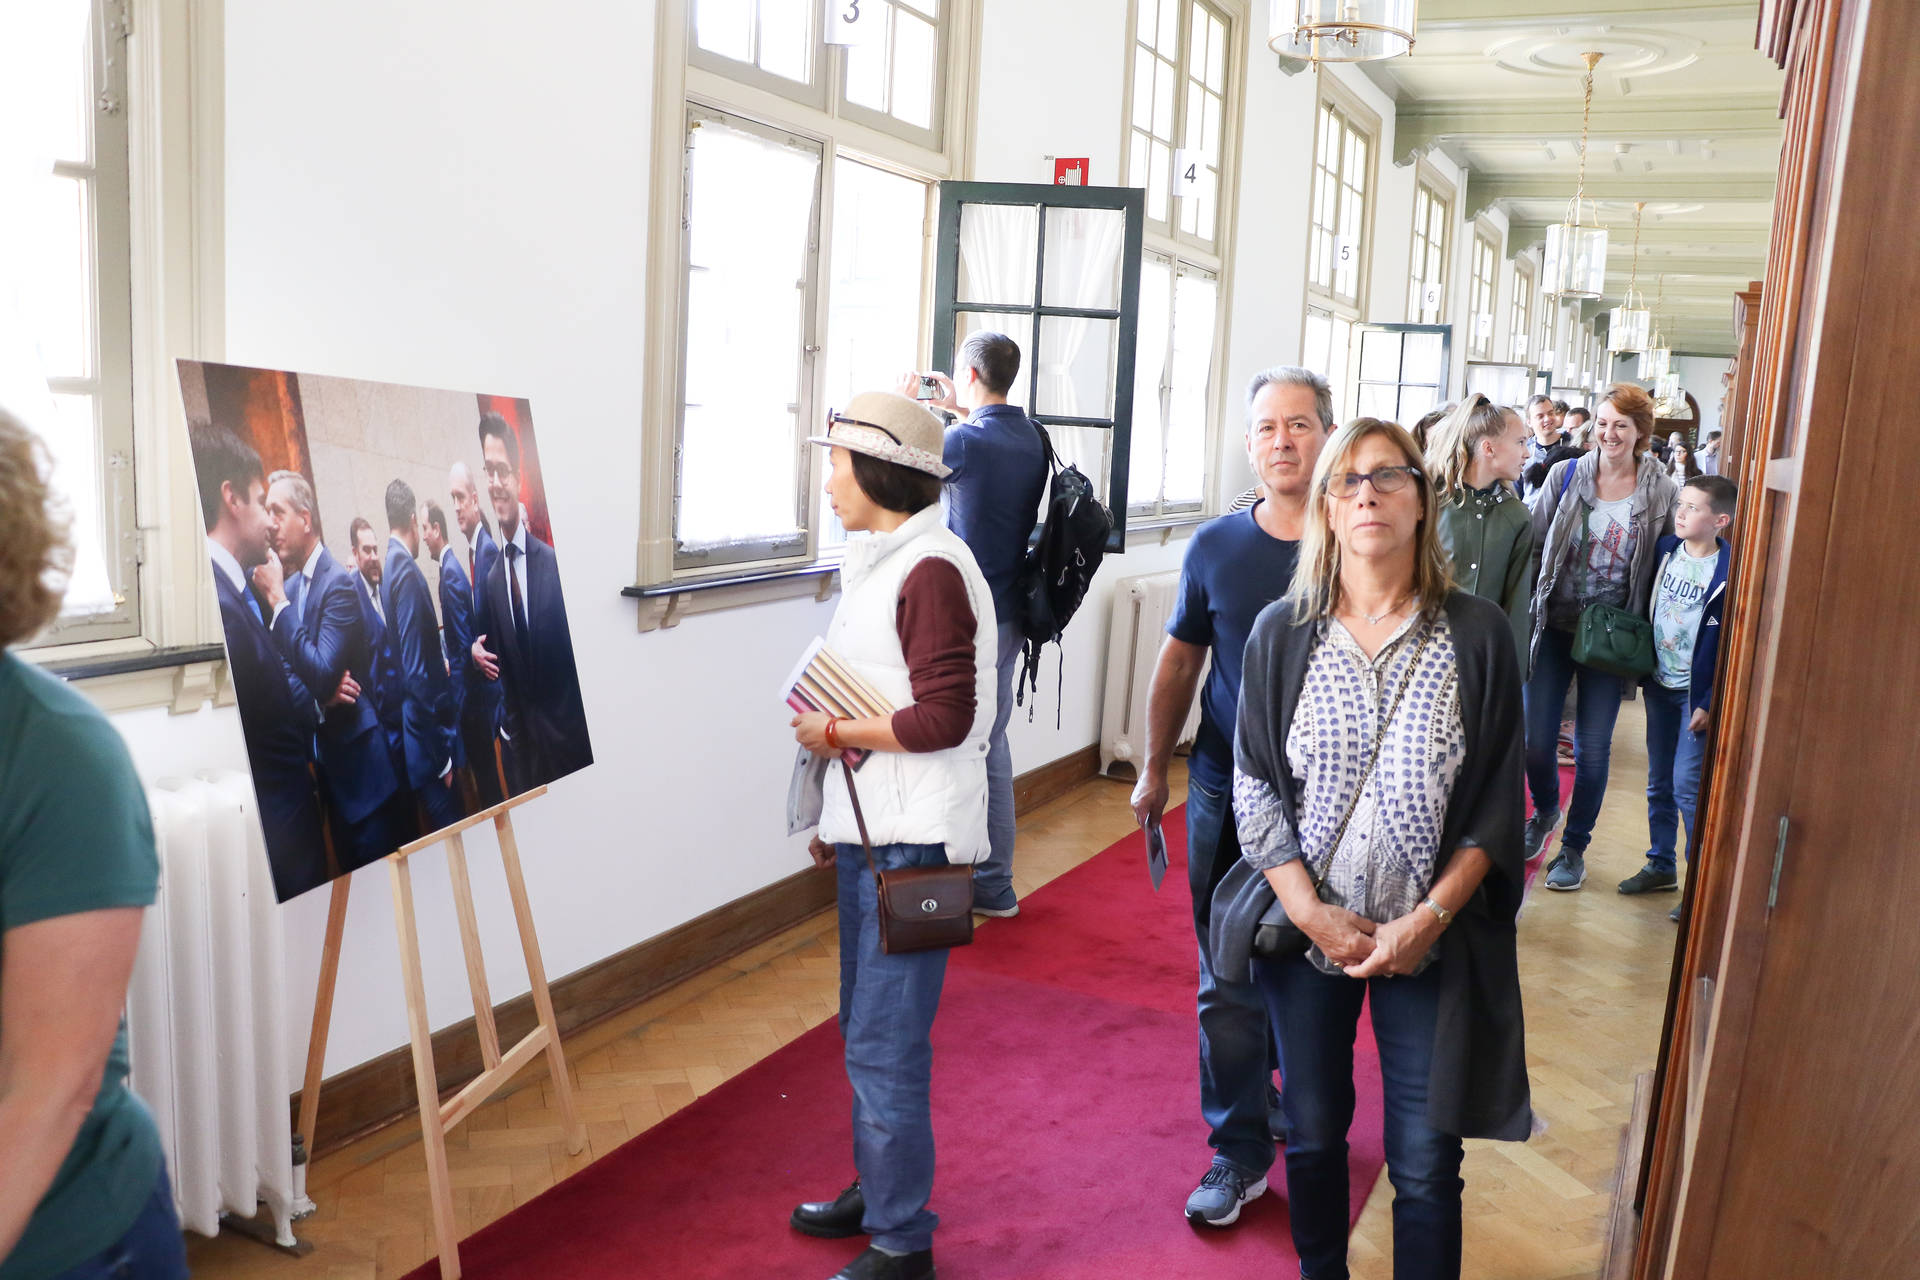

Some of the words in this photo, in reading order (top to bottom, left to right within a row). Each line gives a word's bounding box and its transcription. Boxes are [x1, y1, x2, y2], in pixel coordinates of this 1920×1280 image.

[842, 0, 860, 24] 3
[1184, 163, 1196, 183] 4
[1341, 245, 1350, 260] 5
[1428, 290, 1435, 303] 6
